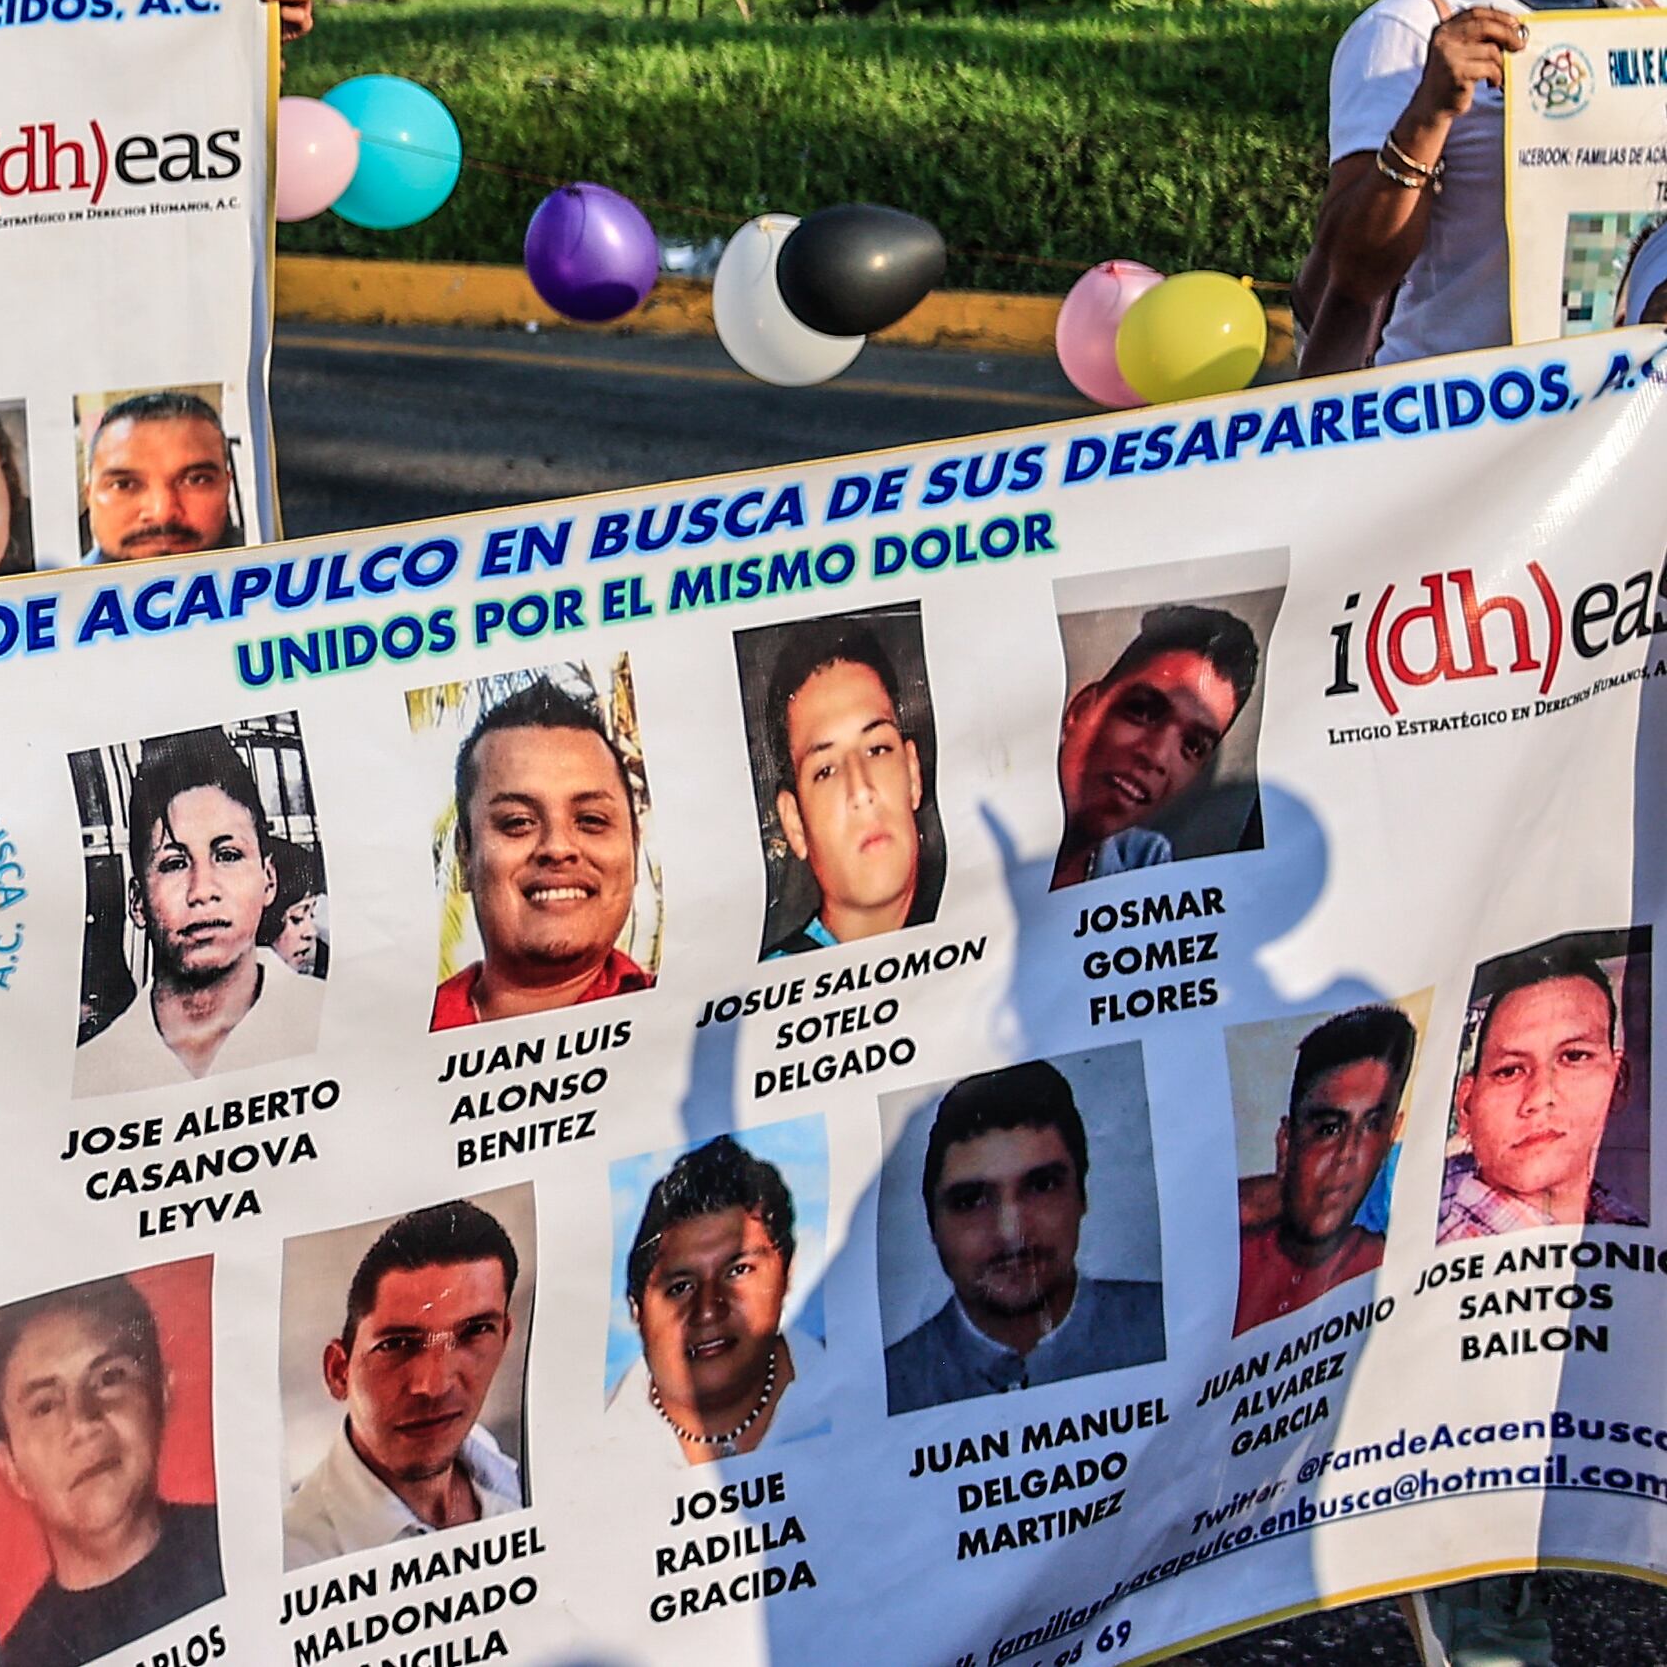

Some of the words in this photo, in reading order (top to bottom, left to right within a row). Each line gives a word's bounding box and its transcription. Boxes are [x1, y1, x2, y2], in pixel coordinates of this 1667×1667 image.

[78, 537, 458, 642] ACAPULCO
[481, 521, 572, 578] EN
[589, 485, 804, 562] BUSCA
[826, 468, 908, 521] DE
[922, 445, 1044, 506] SUS
[1062, 363, 1582, 486] DESAPARECIDOS,
[236, 607, 454, 687] UNIDOS
[474, 589, 585, 645] POR
[603, 576, 653, 621] EL
[670, 543, 856, 612] MISMO
[873, 512, 1056, 579] DOLOR
[1073, 885, 1227, 939] JOSMAR
[696, 978, 806, 1029] JOSUE
[812, 936, 988, 1001] SALOMON
[1082, 932, 1220, 981] GOMEZ
[774, 998, 900, 1050] SOTELO
[1090, 977, 1219, 1027] FLORES
[437, 1036, 545, 1084] JUAN
[556, 1021, 633, 1060] LUIS
[754, 1037, 917, 1099] DELGADO
[60, 1117, 164, 1160] JOSE
[174, 1079, 341, 1142] ALBERTO
[450, 1067, 609, 1125] ALONSO
[85, 1132, 319, 1202] CASANOVA
[456, 1110, 598, 1170] BENITEZ
[139, 1189, 262, 1238] LEYVA
[1414, 1255, 1484, 1296] JOSE
[1458, 1283, 1614, 1321] SANTOS
[1196, 1345, 1269, 1408] JUAN
[1275, 1296, 1396, 1374] ANTONIO
[1461, 1325, 1608, 1362] BAILON
[1230, 1351, 1348, 1427] ALVAREZ
[907, 1429, 1010, 1478] JUAN
[1020, 1397, 1170, 1454] MANUEL
[1229, 1395, 1331, 1458] GARCIA
[670, 1471, 787, 1527] JOSUE
[957, 1451, 1128, 1514] DELGADO
[654, 1515, 807, 1578] RADILLA
[955, 1489, 1127, 1560] MARTINEZ
[279, 1570, 377, 1625] JUAN
[389, 1525, 546, 1592] MANUEL
[648, 1559, 817, 1626] GRACIDA
